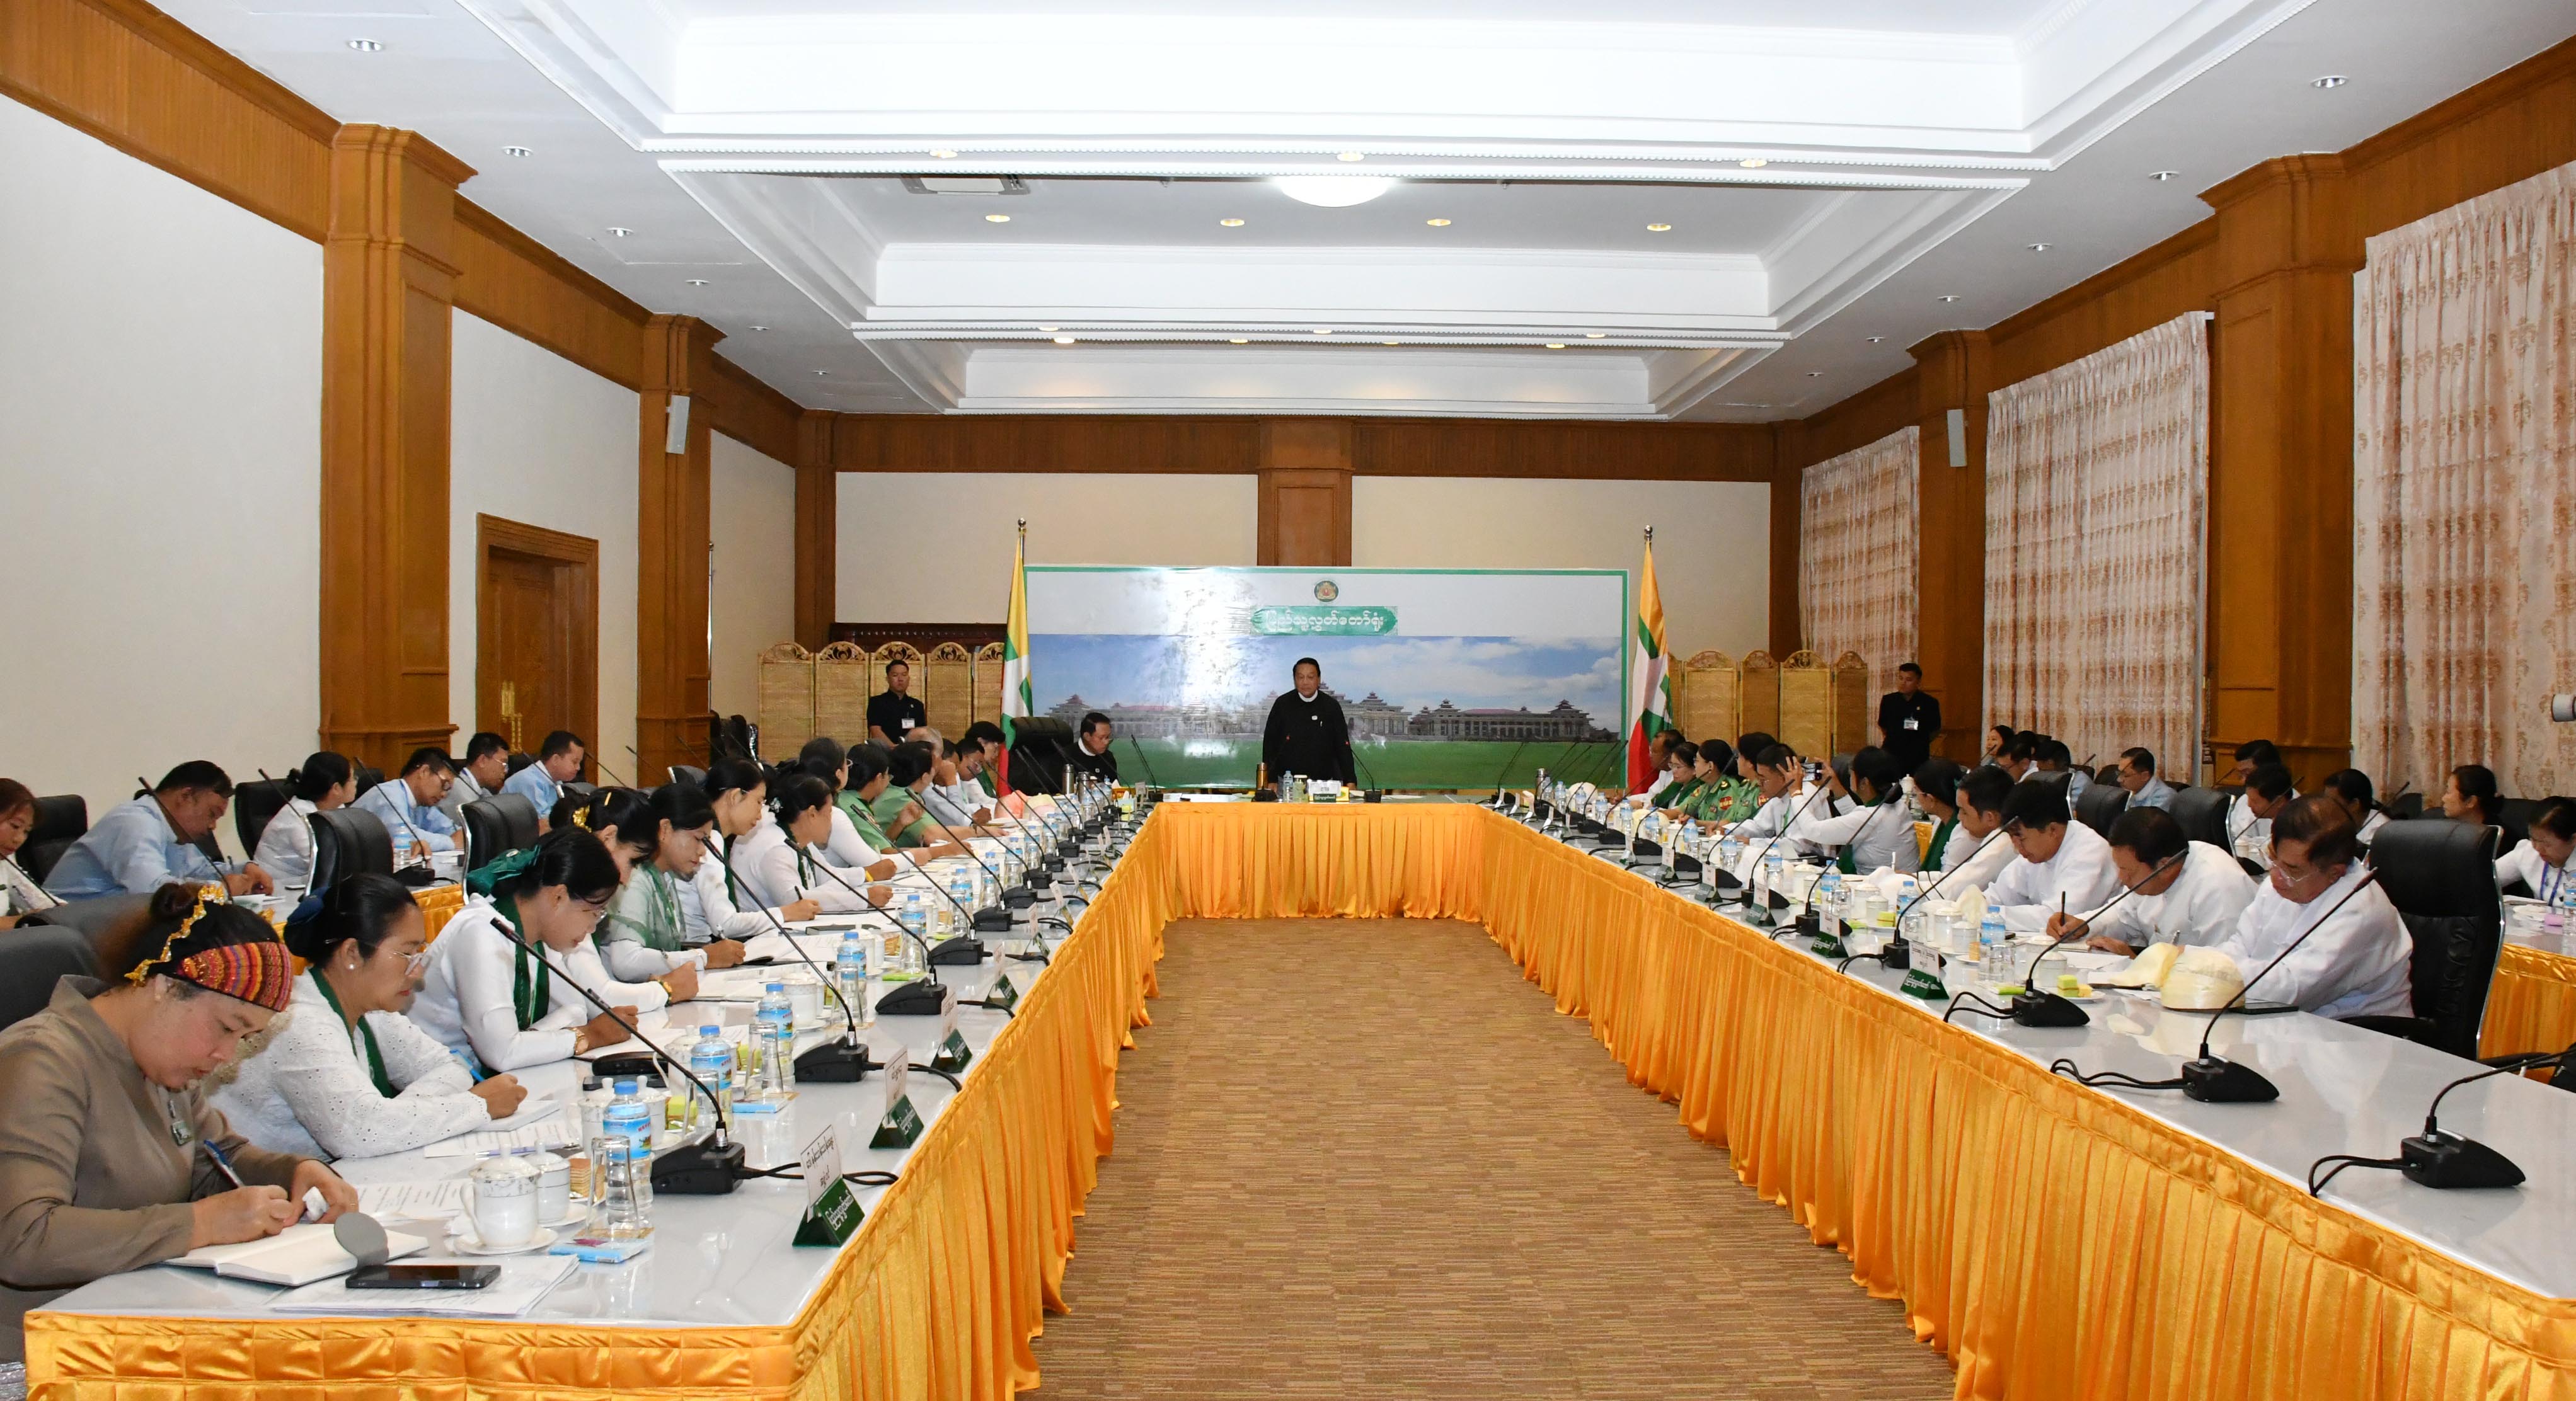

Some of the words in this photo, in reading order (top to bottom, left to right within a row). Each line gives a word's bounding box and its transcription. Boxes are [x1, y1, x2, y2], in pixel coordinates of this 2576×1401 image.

[1265, 609, 1384, 632] ပြည်သူ့လွှတ်တော်ရုံး
